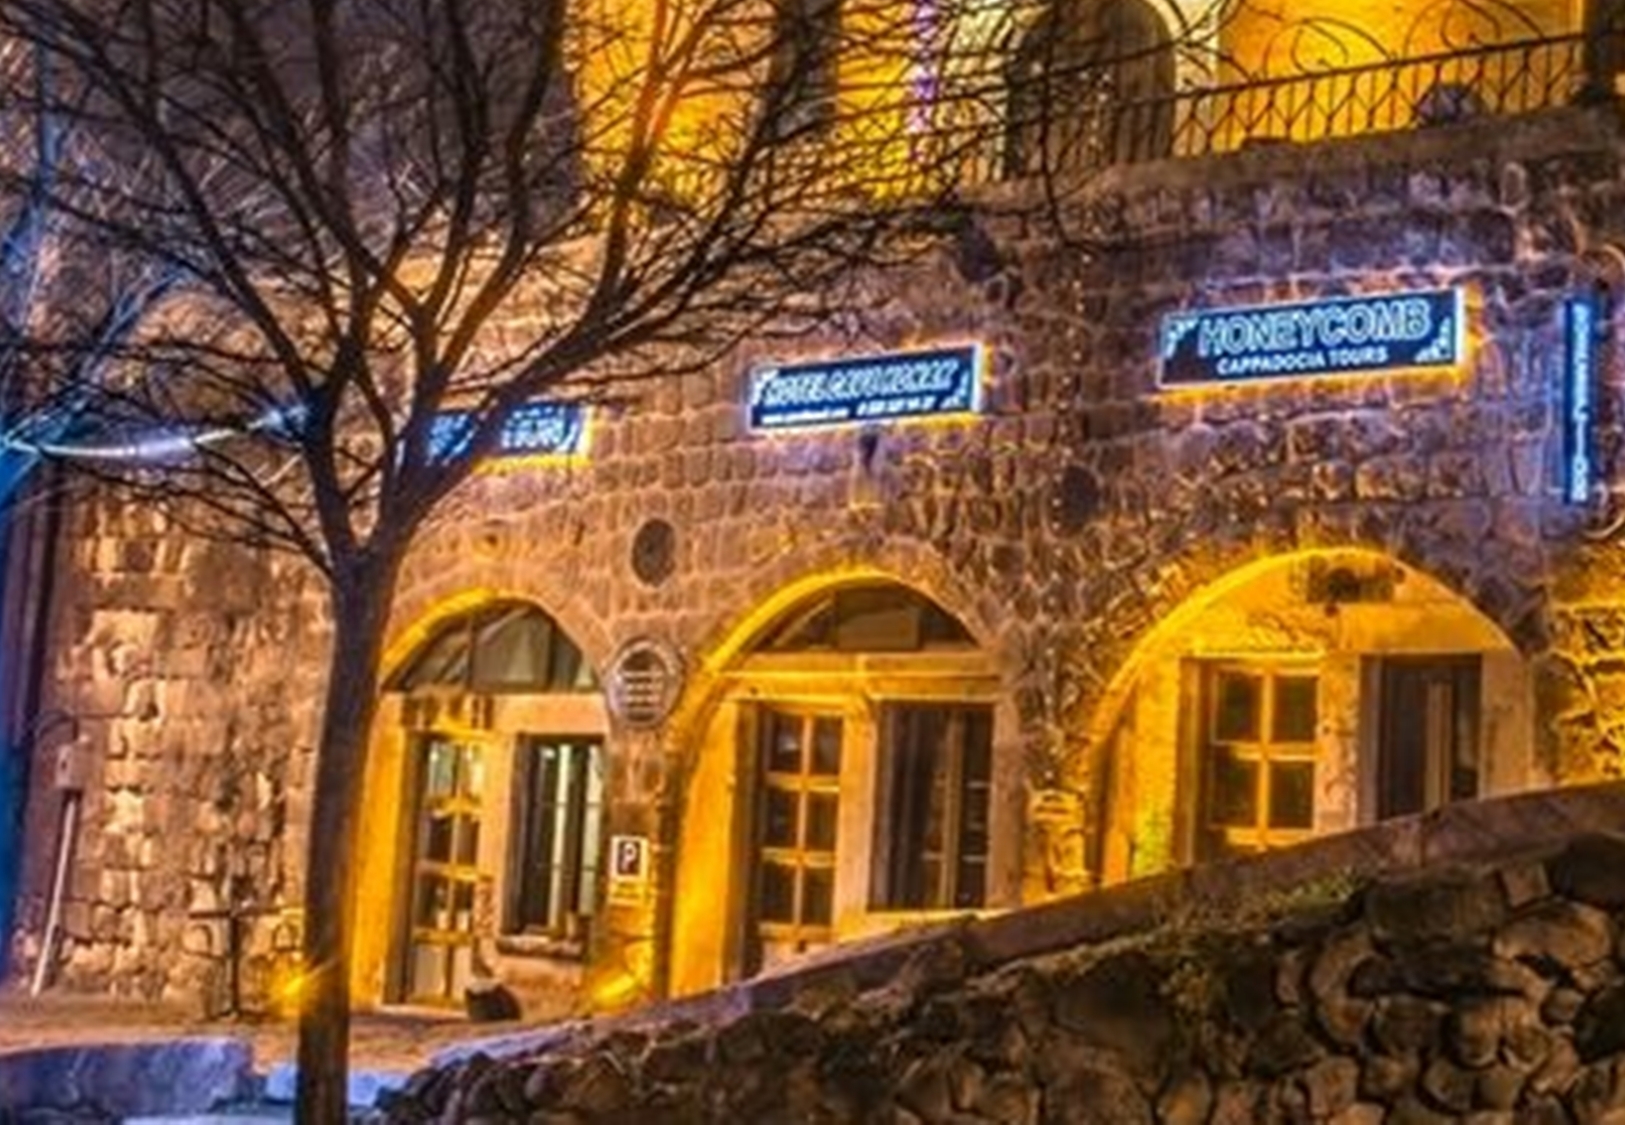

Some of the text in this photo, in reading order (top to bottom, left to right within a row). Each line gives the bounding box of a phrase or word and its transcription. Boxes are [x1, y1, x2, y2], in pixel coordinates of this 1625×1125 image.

[1198, 298, 1432, 357] HONEYCOMB
[1216, 345, 1389, 375] CAPPADOCIA TOURS
